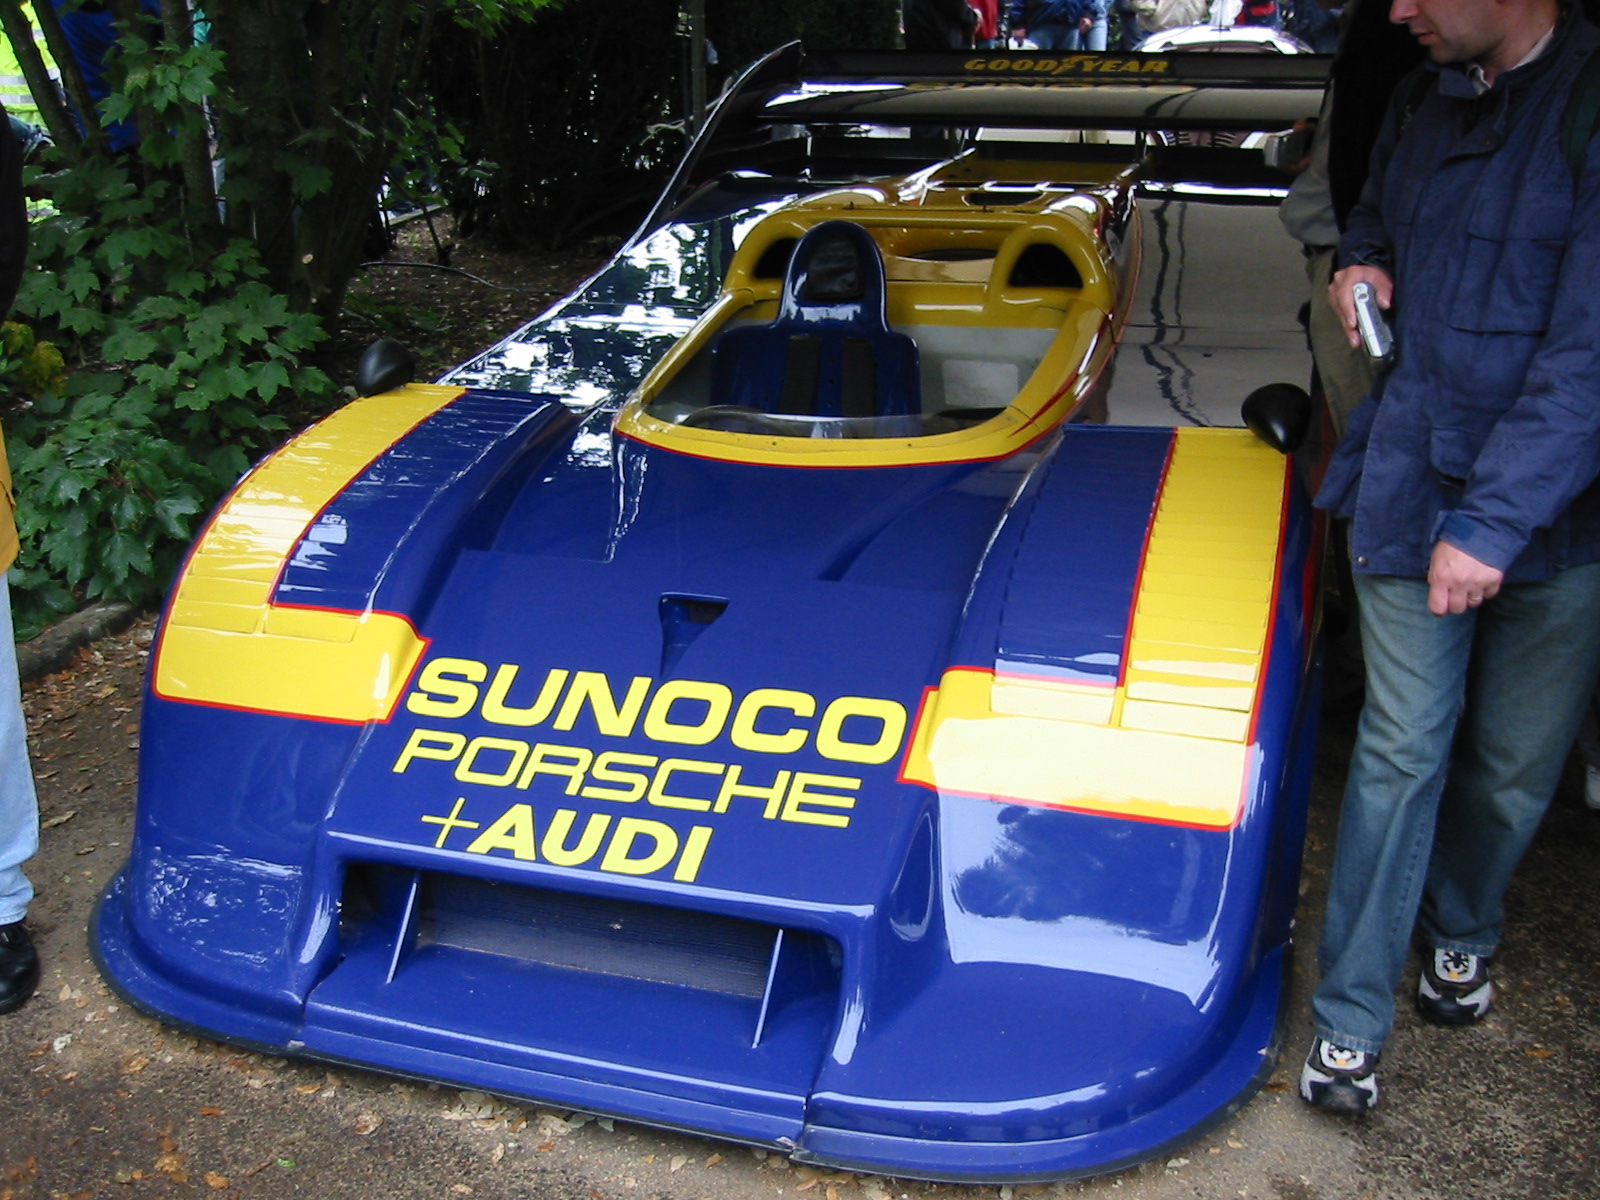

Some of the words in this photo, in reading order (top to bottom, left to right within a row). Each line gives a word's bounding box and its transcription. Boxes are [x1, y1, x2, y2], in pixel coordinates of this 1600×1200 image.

[964, 55, 1169, 74] GOODYEAR
[406, 657, 908, 765] SUNOCO
[392, 728, 863, 828] PORSCHE
